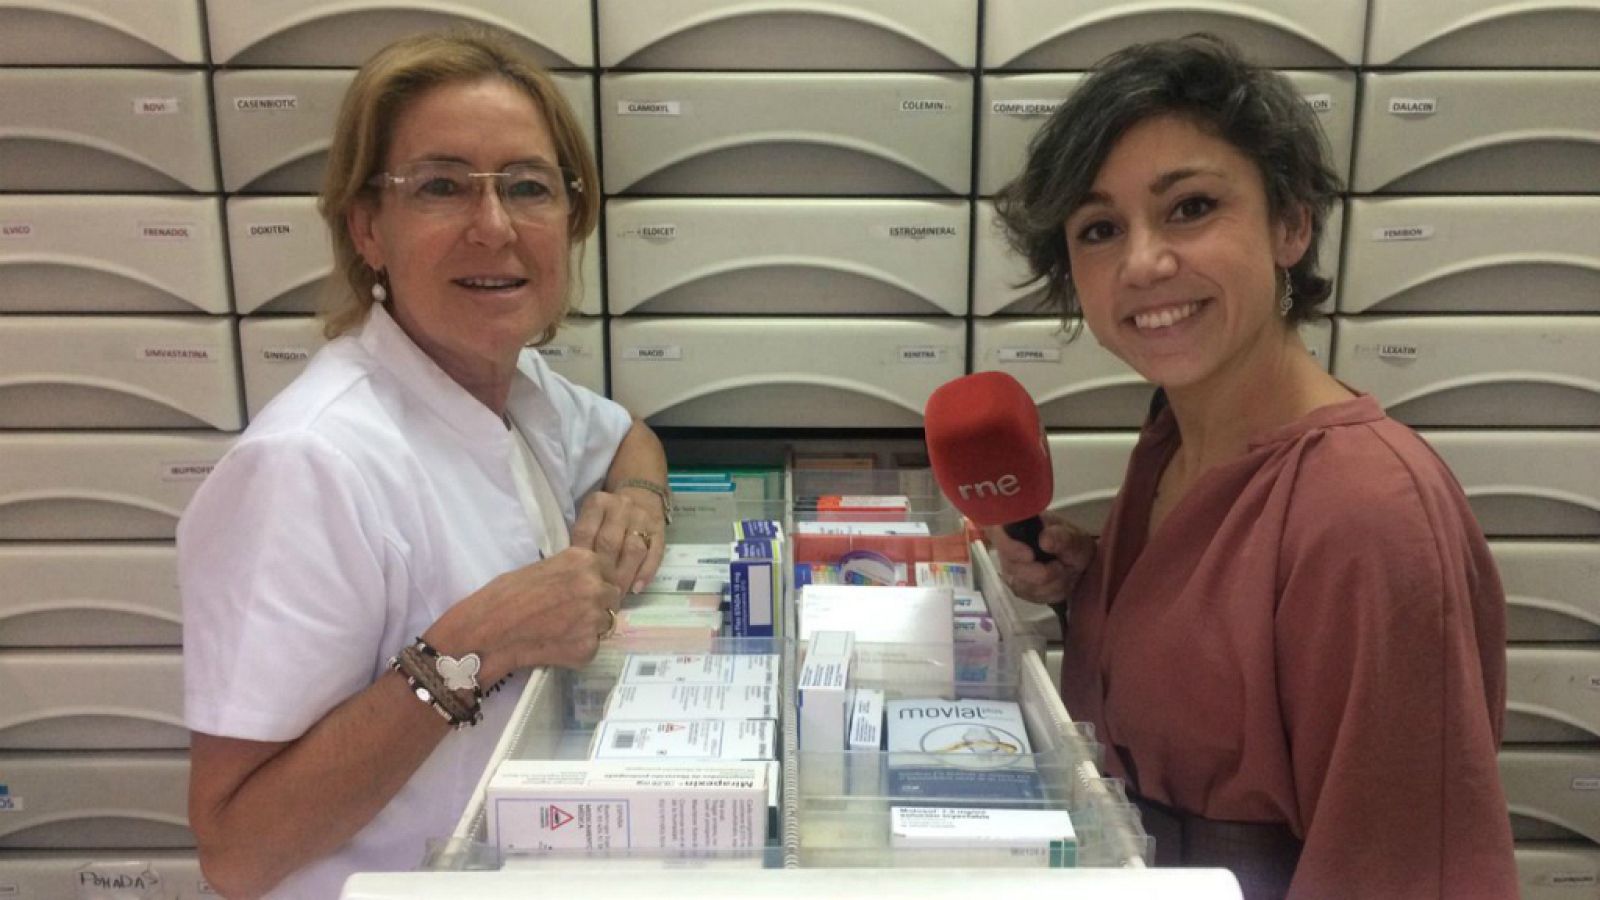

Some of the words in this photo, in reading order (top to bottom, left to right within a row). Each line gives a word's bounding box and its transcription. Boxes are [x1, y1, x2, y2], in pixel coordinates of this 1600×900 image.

[237, 99, 297, 109] CASENBIOTIC
[902, 100, 944, 110] COLEMIN
[1392, 102, 1434, 112] DALACIN
[250, 225, 290, 235] DOXITEN
[889, 226, 957, 236] ESTROMINERAL
[145, 348, 208, 359] SIMVASTATINA
[1381, 345, 1417, 354] LEXATIN
[958, 474, 1021, 501] rne
[0, 799, 14, 809] OS
